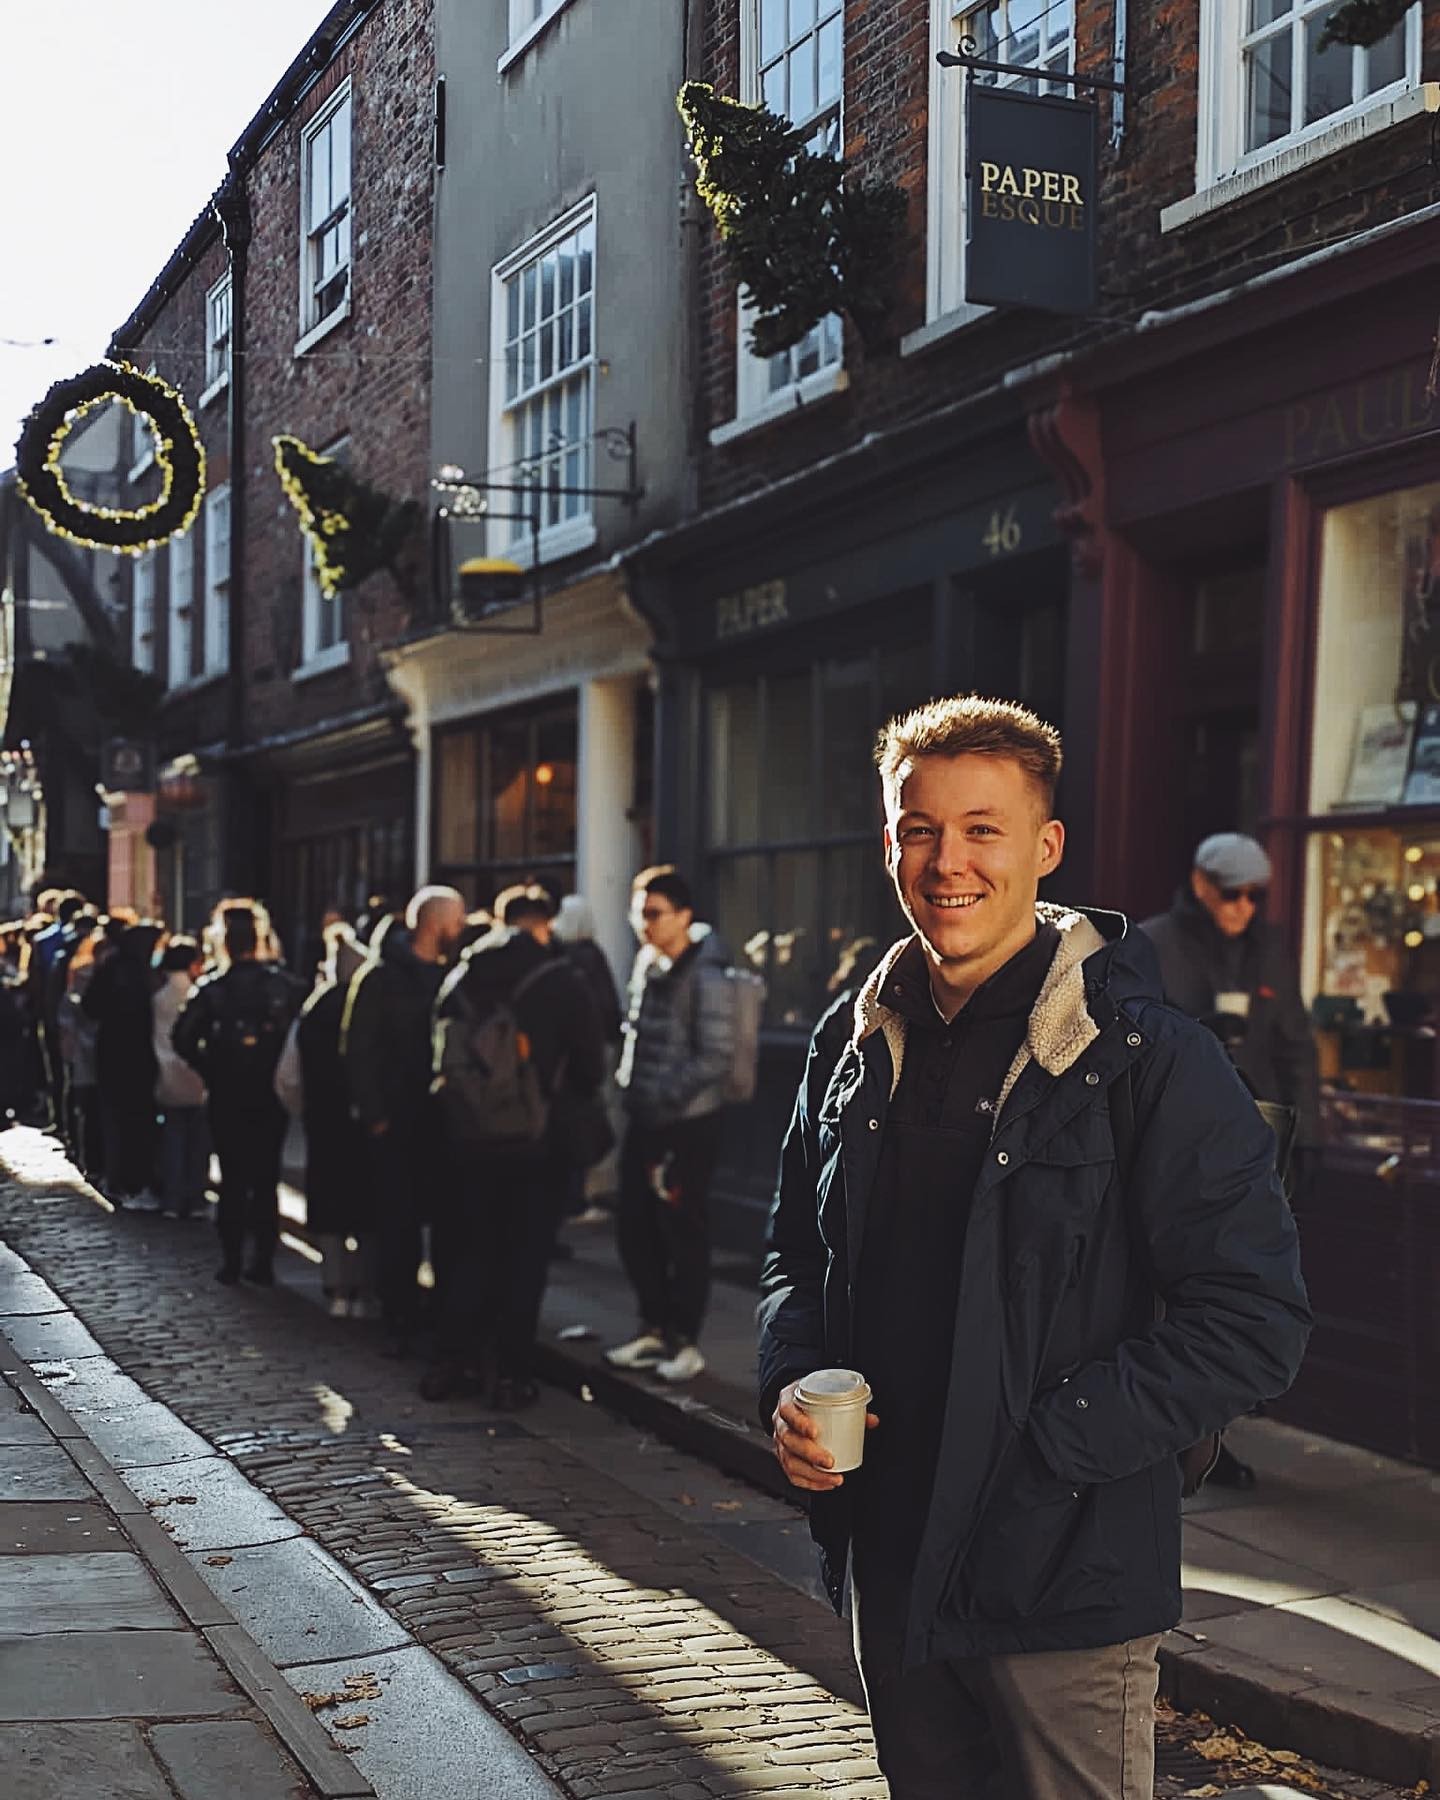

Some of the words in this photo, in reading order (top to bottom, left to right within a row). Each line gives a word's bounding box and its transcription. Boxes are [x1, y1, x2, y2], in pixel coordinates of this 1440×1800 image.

[980, 162, 1084, 205] PAPER
[982, 189, 1084, 230] ESQUE
[982, 505, 1021, 555] 46
[717, 579, 789, 639] PAPER
